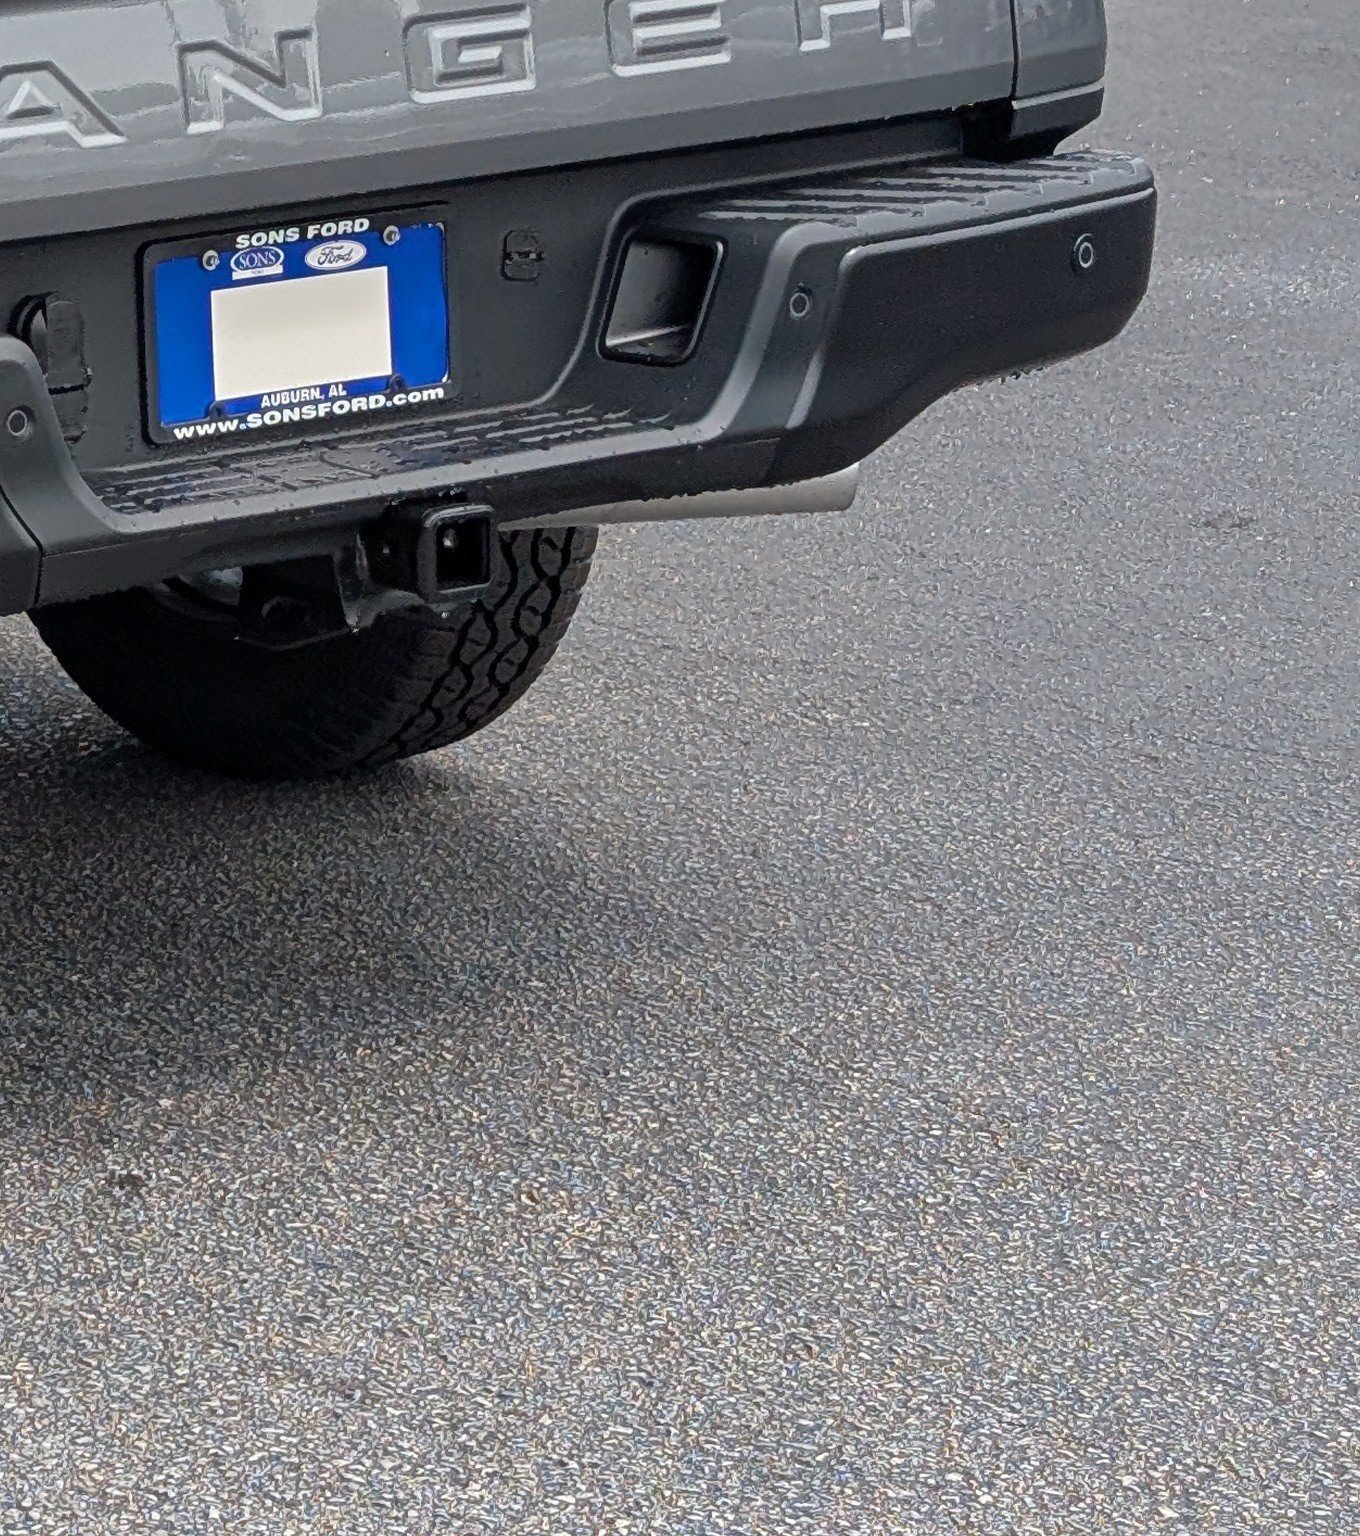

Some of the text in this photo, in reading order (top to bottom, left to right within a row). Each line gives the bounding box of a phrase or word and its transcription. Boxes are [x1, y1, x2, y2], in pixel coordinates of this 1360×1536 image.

[235, 217, 370, 249] SONS FORD
[238, 249, 277, 269] SONS
[317, 244, 355, 266] Ford
[328, 383, 347, 399] AL
[173, 386, 446, 441] www.SONSFORD.com
